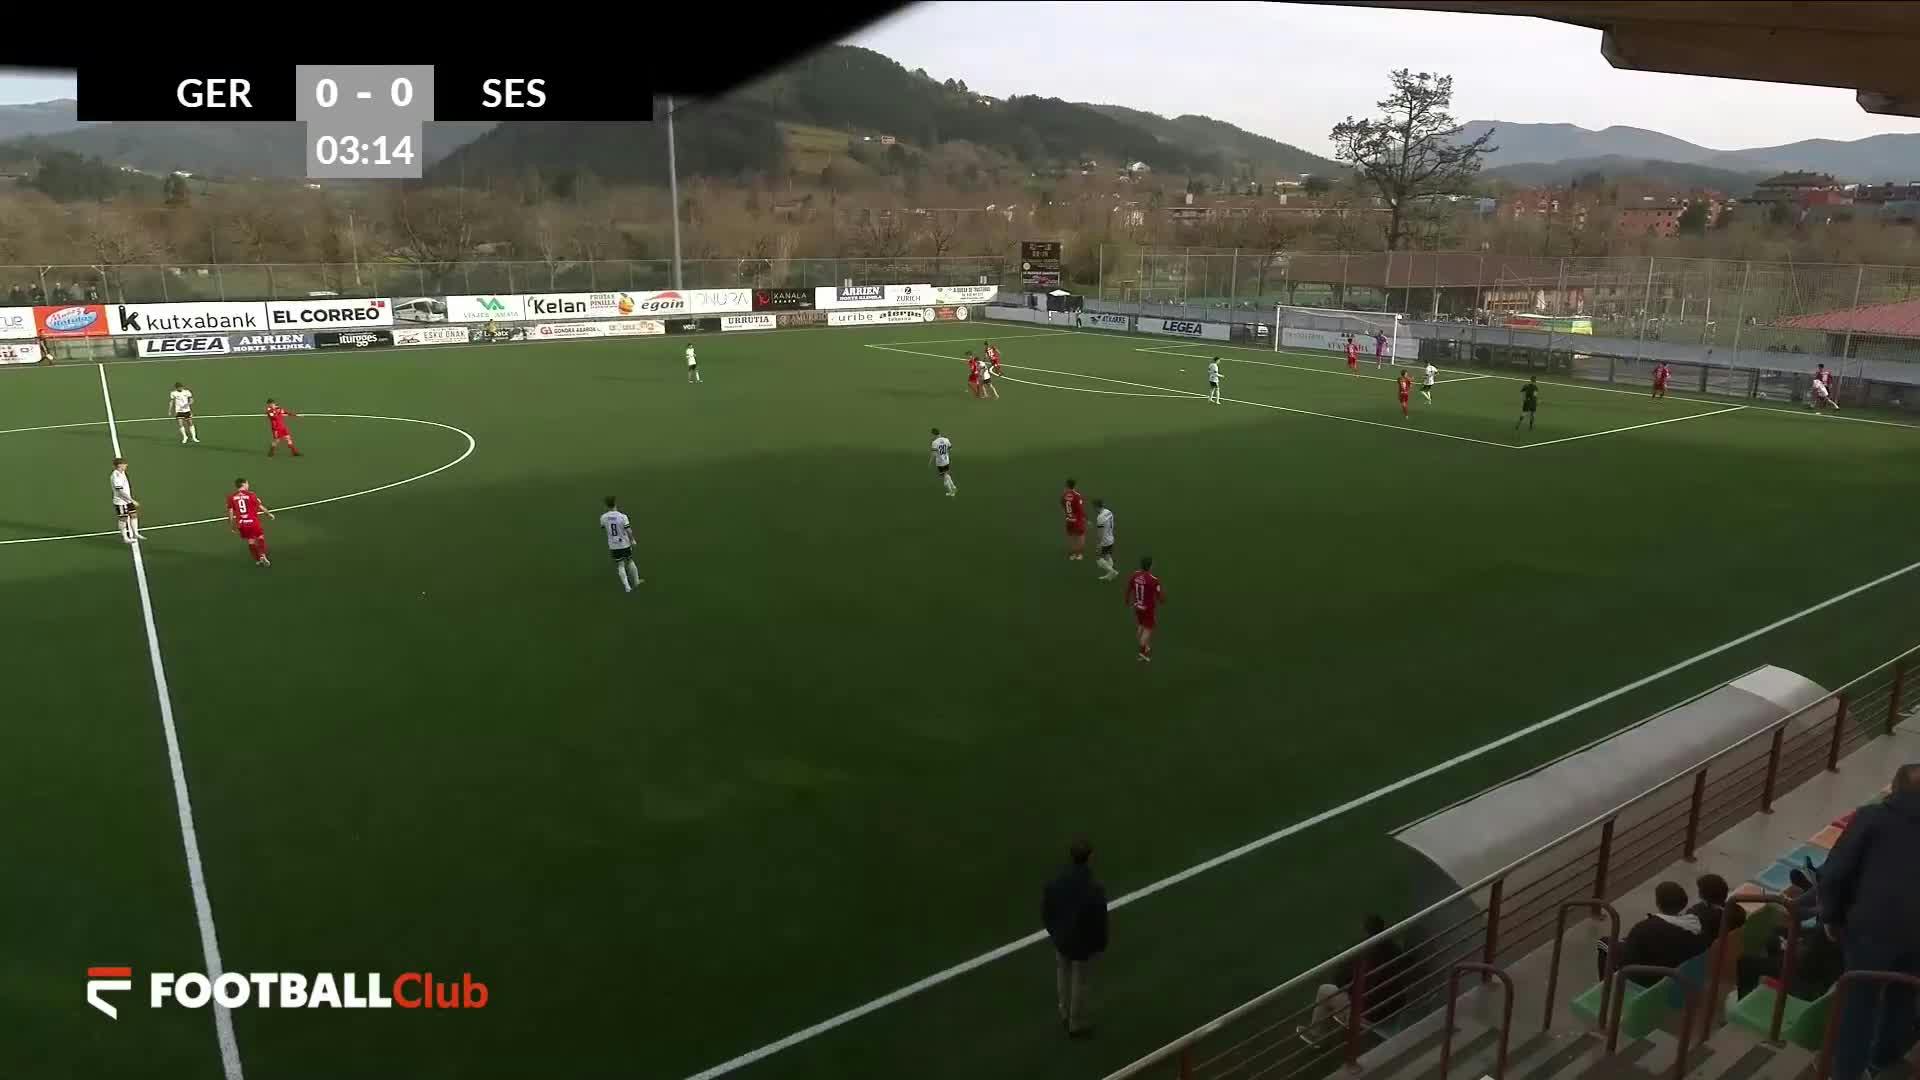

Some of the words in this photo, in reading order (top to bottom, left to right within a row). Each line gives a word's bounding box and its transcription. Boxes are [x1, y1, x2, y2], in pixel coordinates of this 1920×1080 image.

[773, 292, 807, 300] KANALA
[842, 286, 880, 296] ARRIEN
[534, 298, 587, 315] Kelan
[641, 299, 684, 311] egoin
[146, 311, 257, 331] kutxabank
[273, 310, 297, 324] EL
[300, 307, 380, 323] CORREO
[727, 316, 769, 325] URRUTIA
[838, 313, 873, 322] uribe
[1162, 320, 1203, 335] LEGEA
[146, 337, 224, 353] LEGEA
[239, 333, 305, 346] ARRIEN
[238, 499, 247, 513] 9
[610, 523, 618, 537] 8
